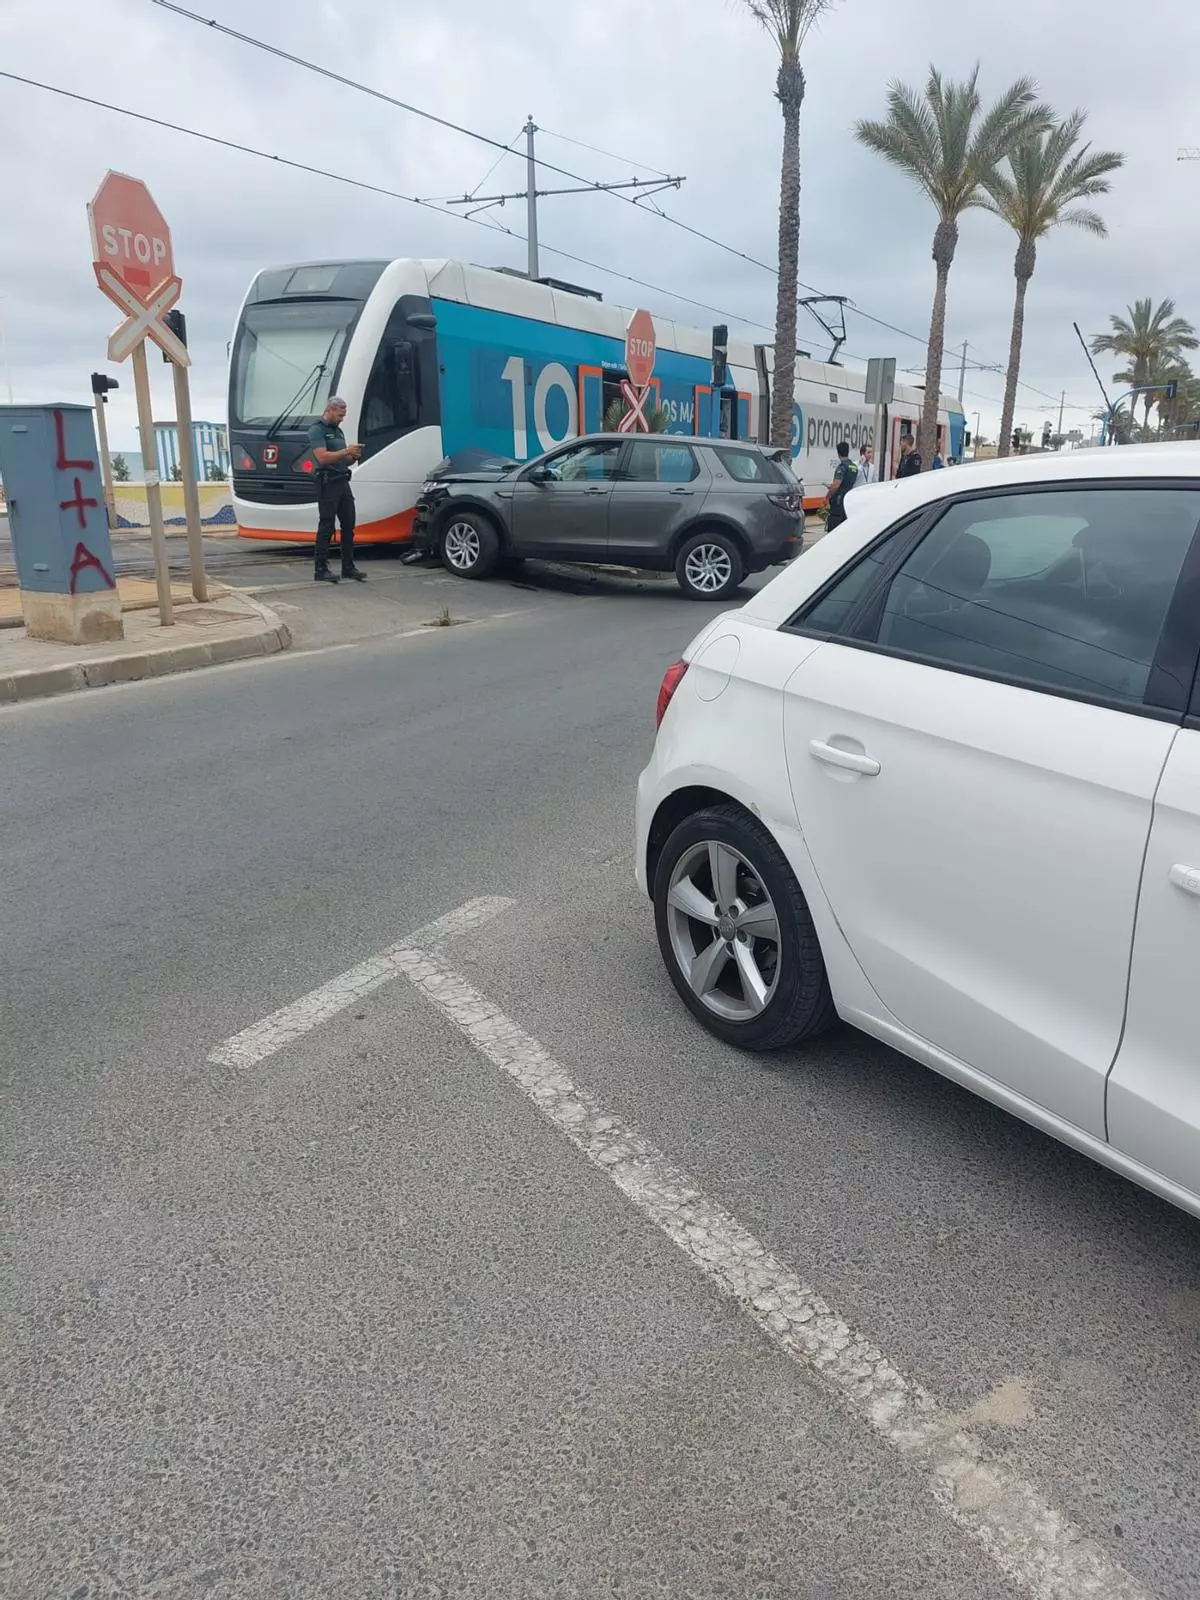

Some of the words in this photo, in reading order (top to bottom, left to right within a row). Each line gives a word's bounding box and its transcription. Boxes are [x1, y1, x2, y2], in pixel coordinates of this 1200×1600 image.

[102, 224, 167, 266] STOP
[630, 338, 653, 357] STOP
[501, 356, 578, 459] 10
[807, 414, 874, 458] promedios
